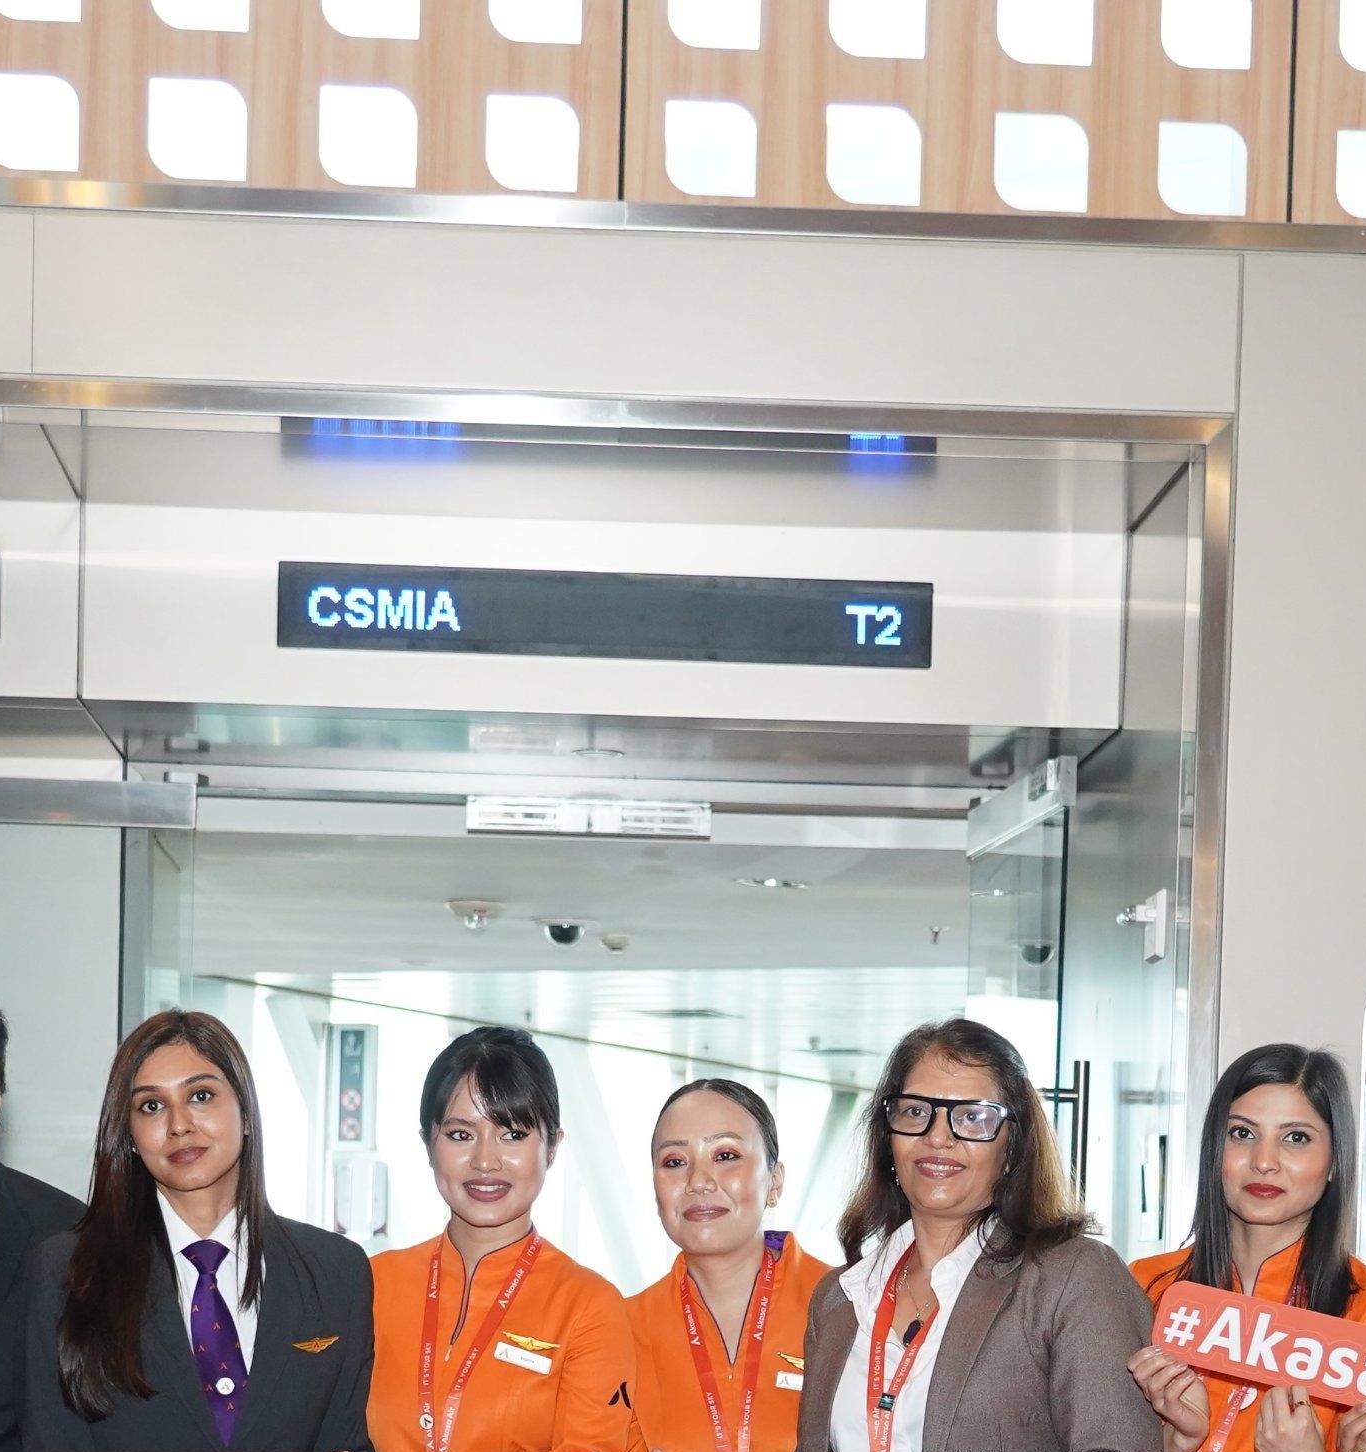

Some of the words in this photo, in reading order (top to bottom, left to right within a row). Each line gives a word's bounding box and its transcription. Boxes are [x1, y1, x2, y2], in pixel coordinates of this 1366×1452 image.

[307, 586, 461, 631] CSMIA
[845, 604, 902, 646] T2
[756, 1307, 767, 1330] Akasa
[873, 1354, 882, 1376] YOUR
[898, 1357, 912, 1379] YOUR
[907, 1343, 918, 1359] SKY
